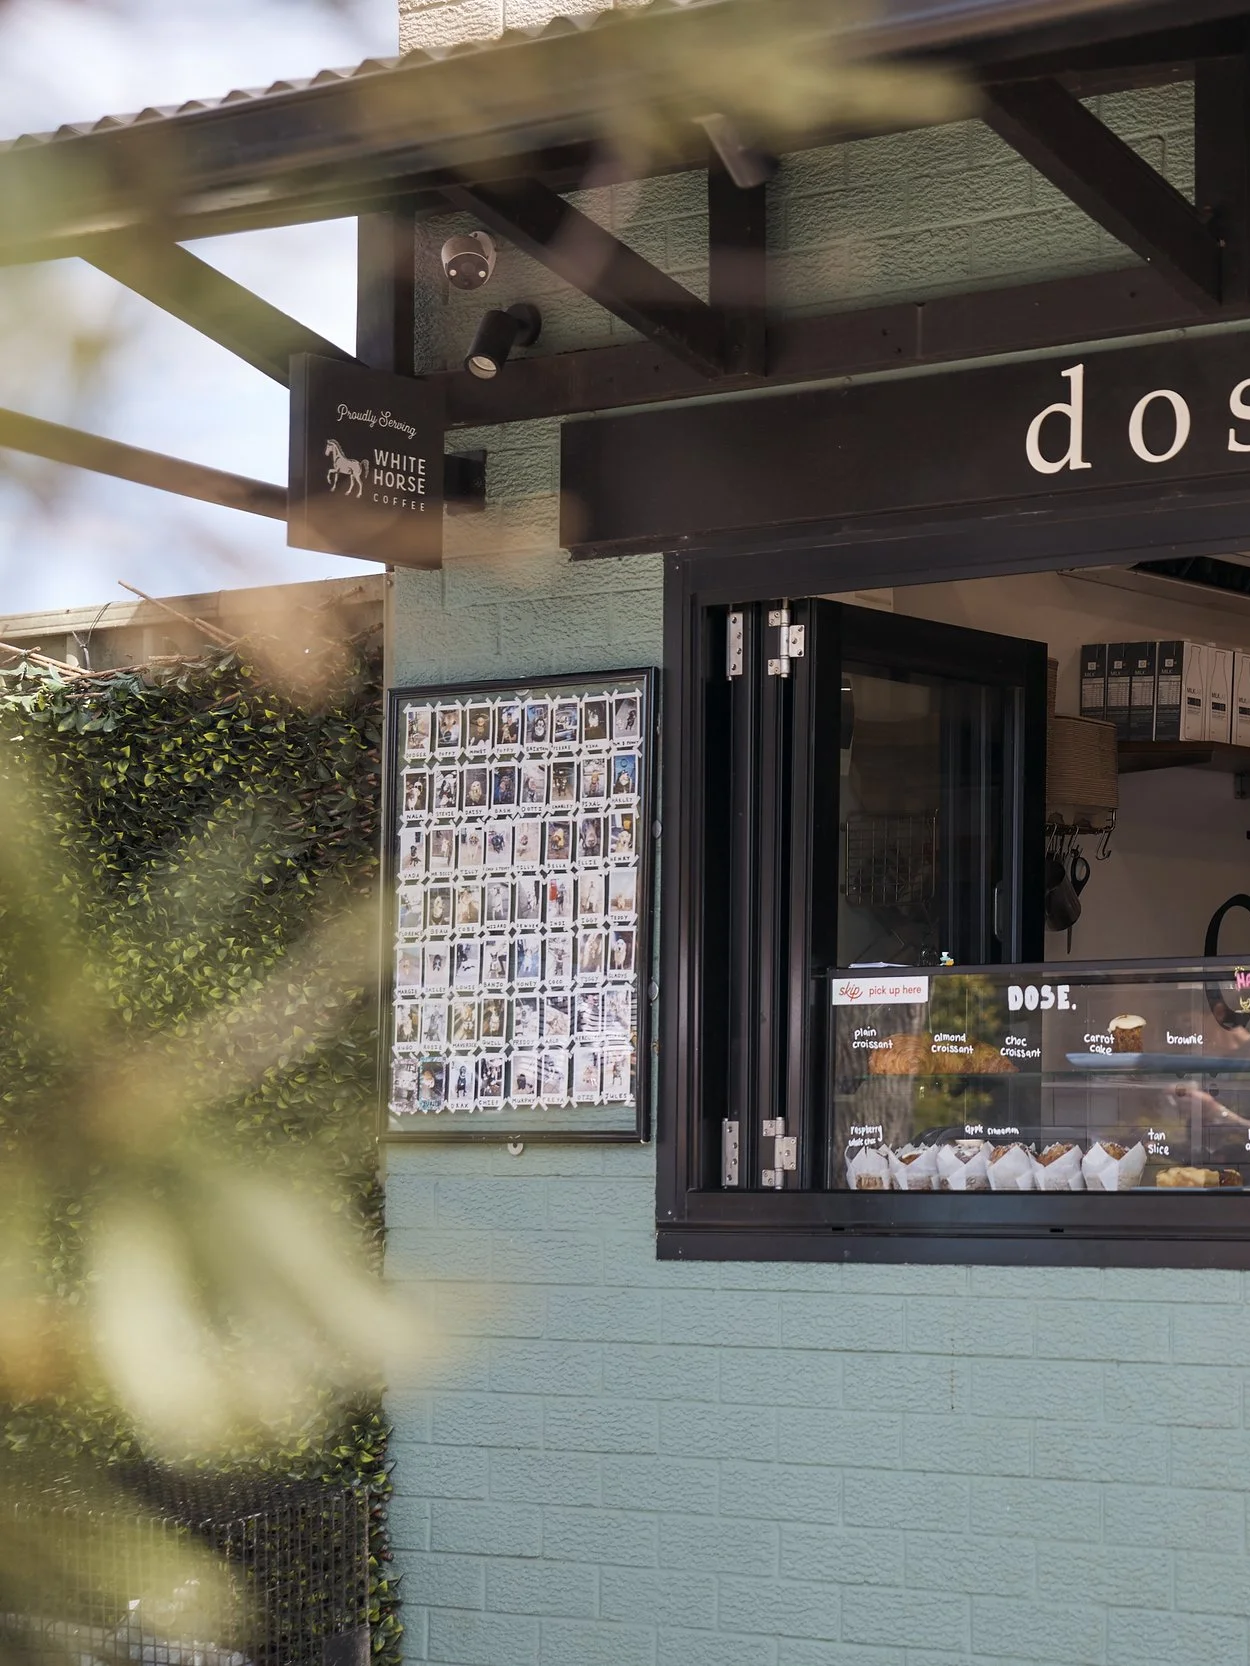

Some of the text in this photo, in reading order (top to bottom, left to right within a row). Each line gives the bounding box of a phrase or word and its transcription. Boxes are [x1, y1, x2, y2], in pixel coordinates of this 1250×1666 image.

[337, 403, 417, 440] Proudly Serving
[374, 448, 426, 476] WHITE
[374, 468, 426, 495] HORSE
[373, 493, 425, 512] COFFEE
[839, 981, 922, 1001] skip pick up here
[1007, 984, 1077, 1012] DOSE.
[854, 1027, 877, 1039] plain
[934, 1032, 967, 1043] almond
[1084, 1033, 1115, 1045] carrot
[1166, 1031, 1204, 1045] brownie
[852, 1039, 893, 1050] croissant
[1005, 1035, 1027, 1047] choc
[931, 1043, 974, 1055] croissant
[1000, 1047, 1042, 1059] croissant
[1089, 1044, 1113, 1056] cake
[850, 1124, 883, 1142] raspberry
[1148, 1128, 1166, 1141] tan
[1148, 1143, 1170, 1156] slice
